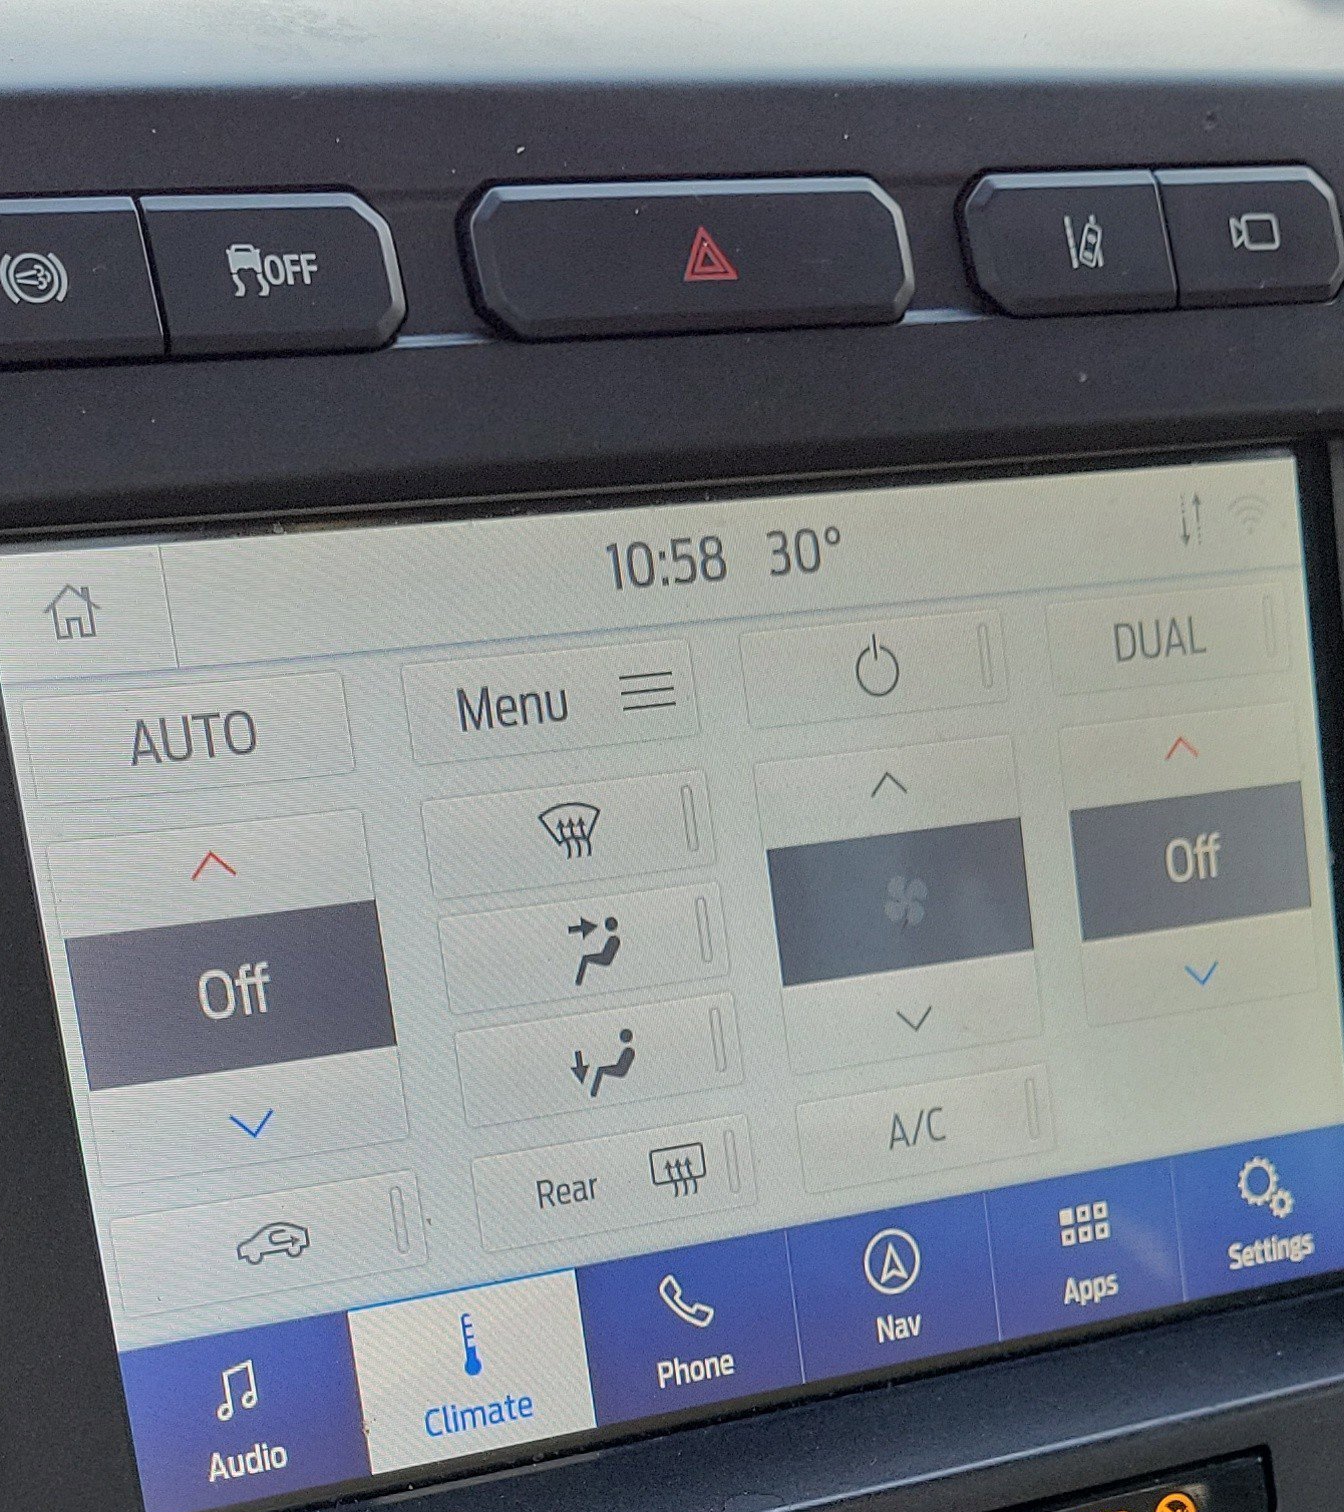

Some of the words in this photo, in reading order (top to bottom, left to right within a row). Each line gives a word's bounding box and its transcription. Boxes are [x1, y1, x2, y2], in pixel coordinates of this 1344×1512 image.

[264, 252, 318, 287] OFF
[605, 535, 729, 590] 10:58
[765, 526, 842, 577] 30°
[1113, 616, 1207, 663] DUAL
[456, 686, 570, 734] Menu
[130, 709, 258, 767] AUTO
[1164, 832, 1222, 884] Off
[197, 962, 271, 1021] Off
[887, 1105, 947, 1152] A/C
[536, 1173, 599, 1210] Rear
[1228, 1228, 1316, 1273] Settings
[1063, 1271, 1119, 1308] Apps
[875, 1312, 923, 1345] Nav
[656, 1348, 736, 1391] Phone
[424, 1393, 534, 1439] Climate
[207, 1443, 289, 1484] Audio
